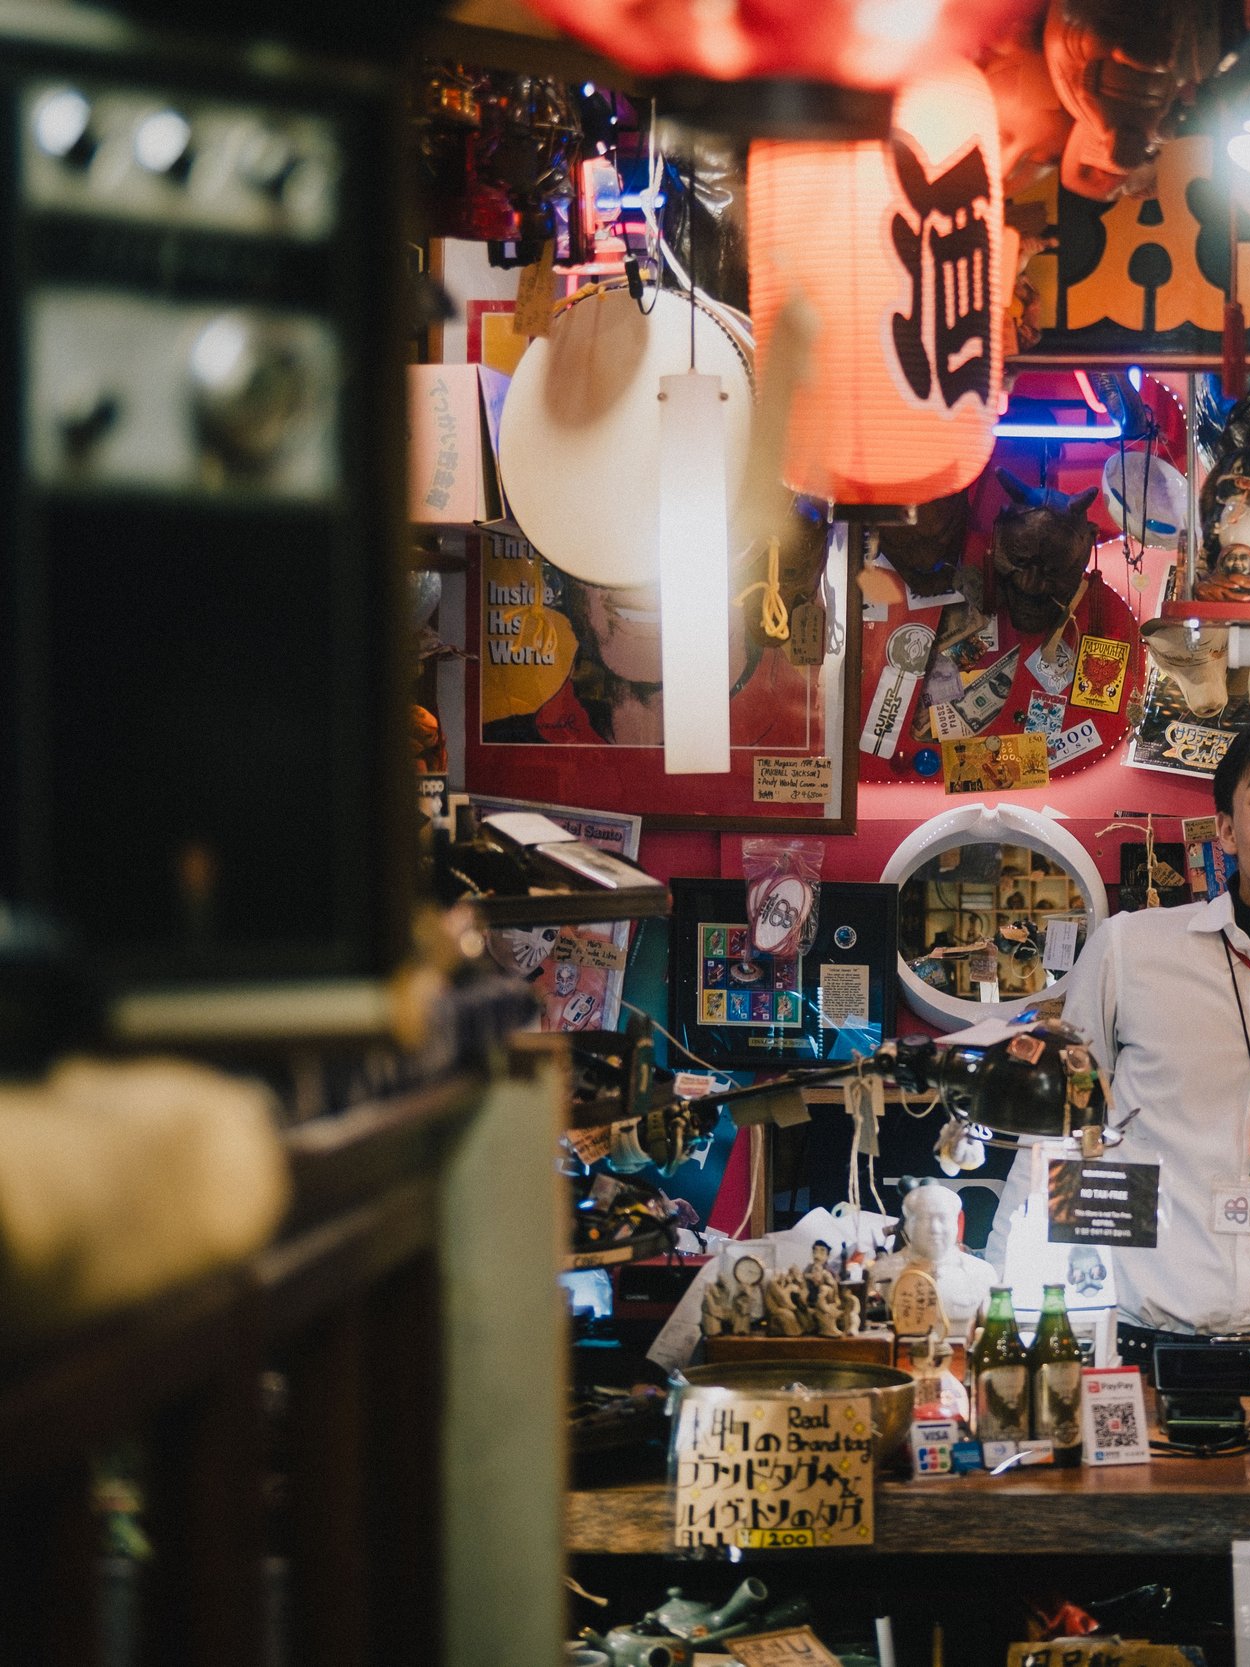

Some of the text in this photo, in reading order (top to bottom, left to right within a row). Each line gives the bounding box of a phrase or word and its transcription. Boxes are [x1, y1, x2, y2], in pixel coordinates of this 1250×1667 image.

[873, 687, 895, 737] GUITAR
[883, 696, 903, 734] WARS
[585, 822, 624, 842] Santo
[1101, 1381, 1134, 1393] PayPay
[787, 1404, 830, 1429] Real
[787, 1431, 873, 1464] Brand tag
[924, 1430, 949, 1441] VISA
[675, 1497, 865, 1532] ルイヴィトンのタグ
